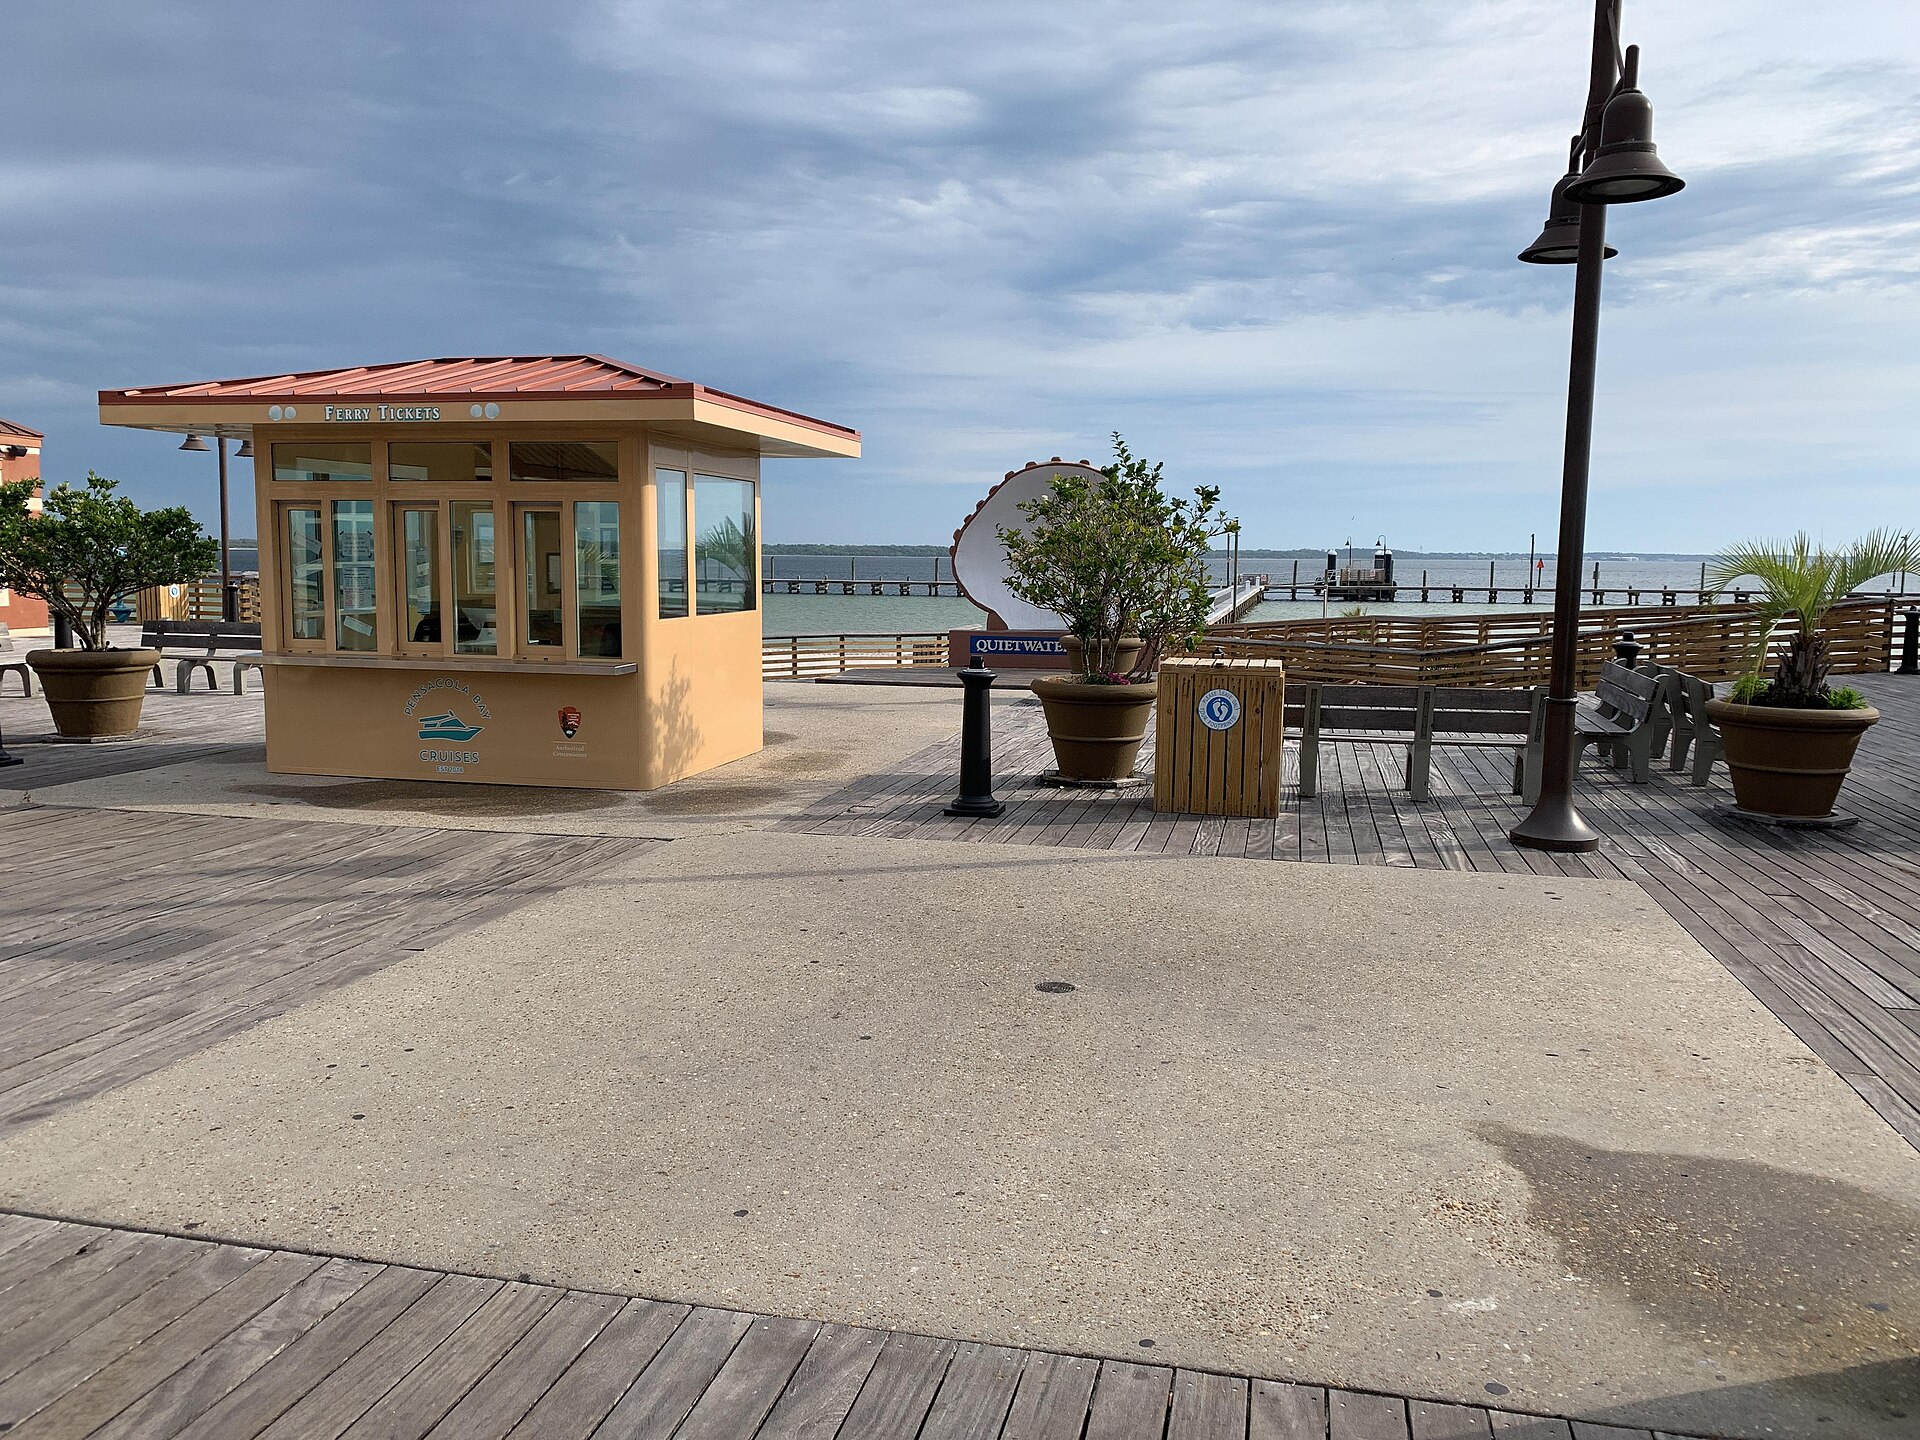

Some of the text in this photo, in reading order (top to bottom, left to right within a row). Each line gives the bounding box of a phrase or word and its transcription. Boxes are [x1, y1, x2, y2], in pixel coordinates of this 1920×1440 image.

[324, 404, 441, 421] FERRY TICKETS
[976, 639, 1067, 653] QUIETWATE
[404, 678, 492, 720] PENSACOLA BAY
[419, 749, 480, 764] CRUISES
